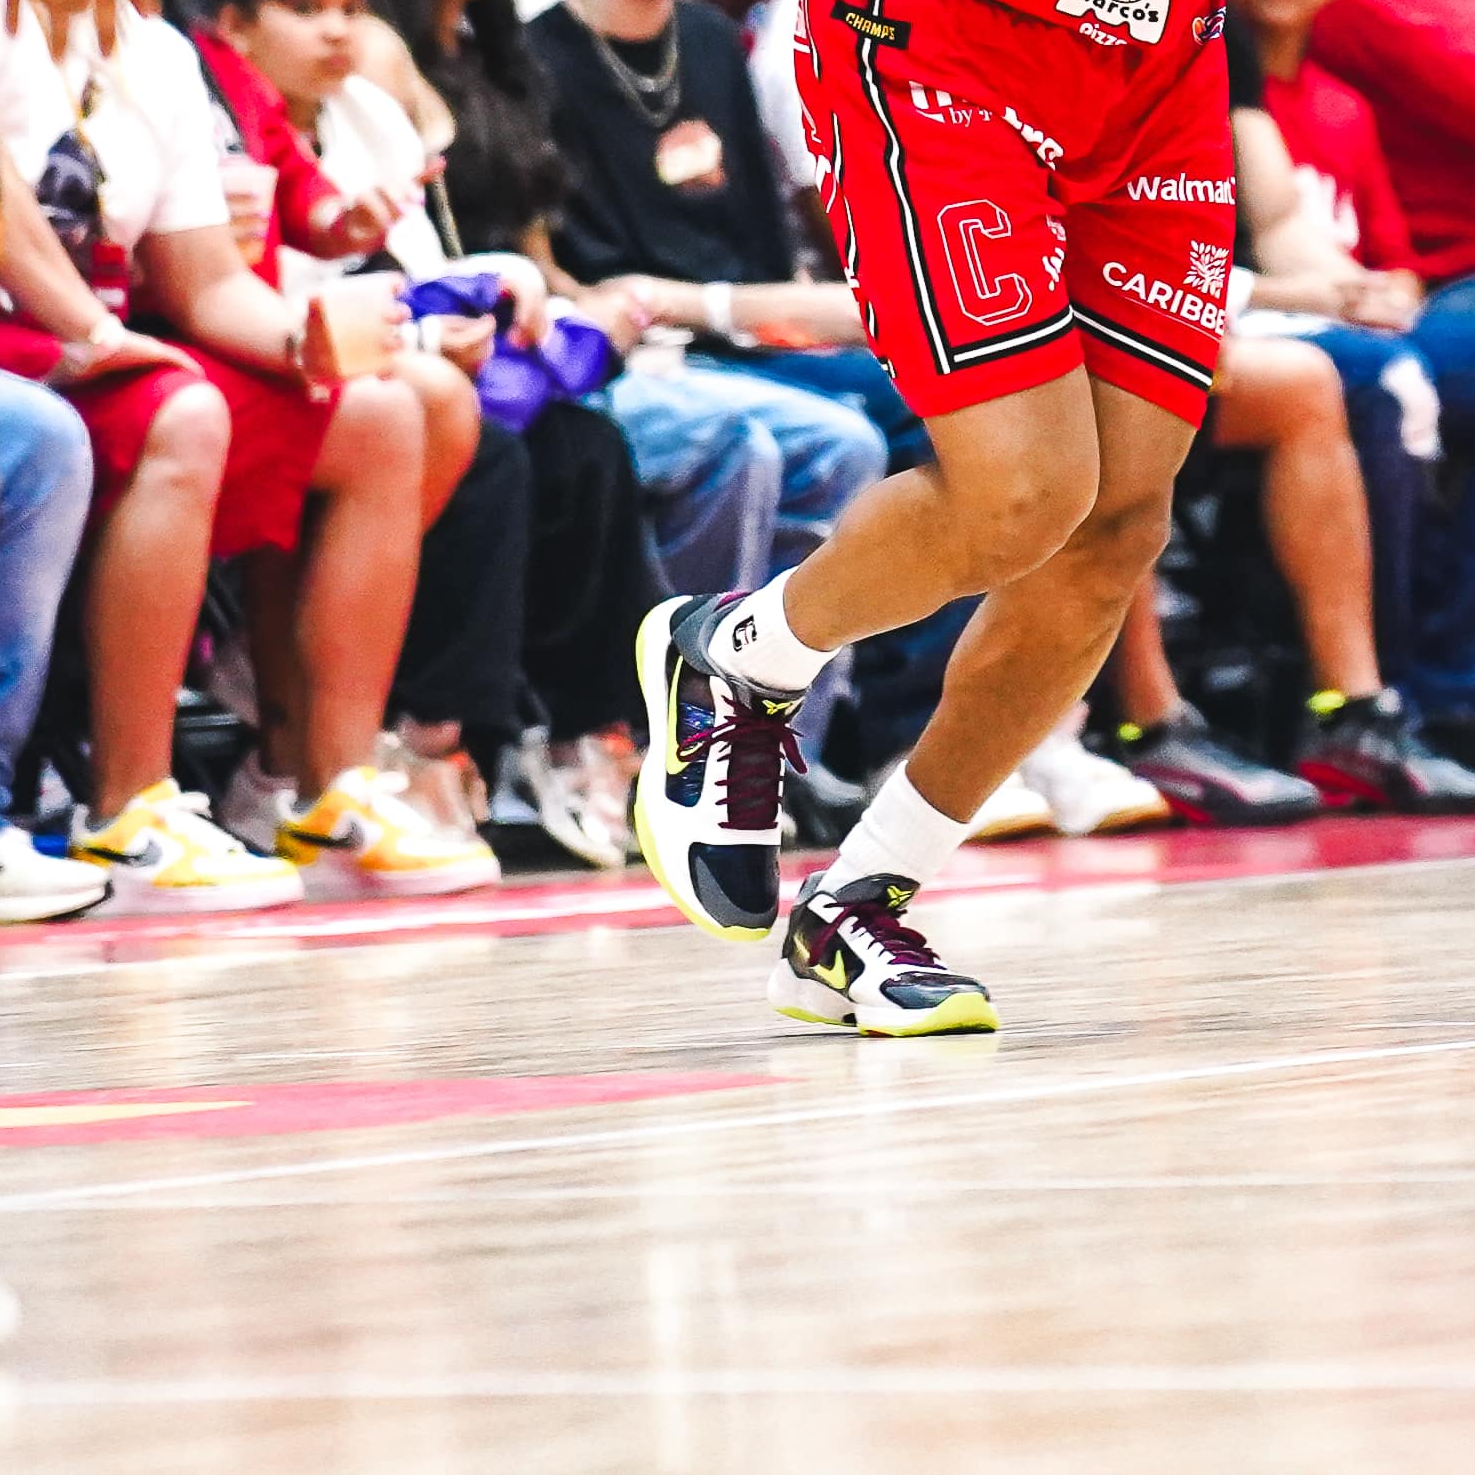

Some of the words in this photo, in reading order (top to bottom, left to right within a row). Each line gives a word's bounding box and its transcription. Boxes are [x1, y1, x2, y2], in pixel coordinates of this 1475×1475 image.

[845, 11, 896, 41] CHAMPS
[949, 106, 973, 128] by
[936, 198, 1033, 327] C
[1101, 261, 1226, 336] CARIBBE
